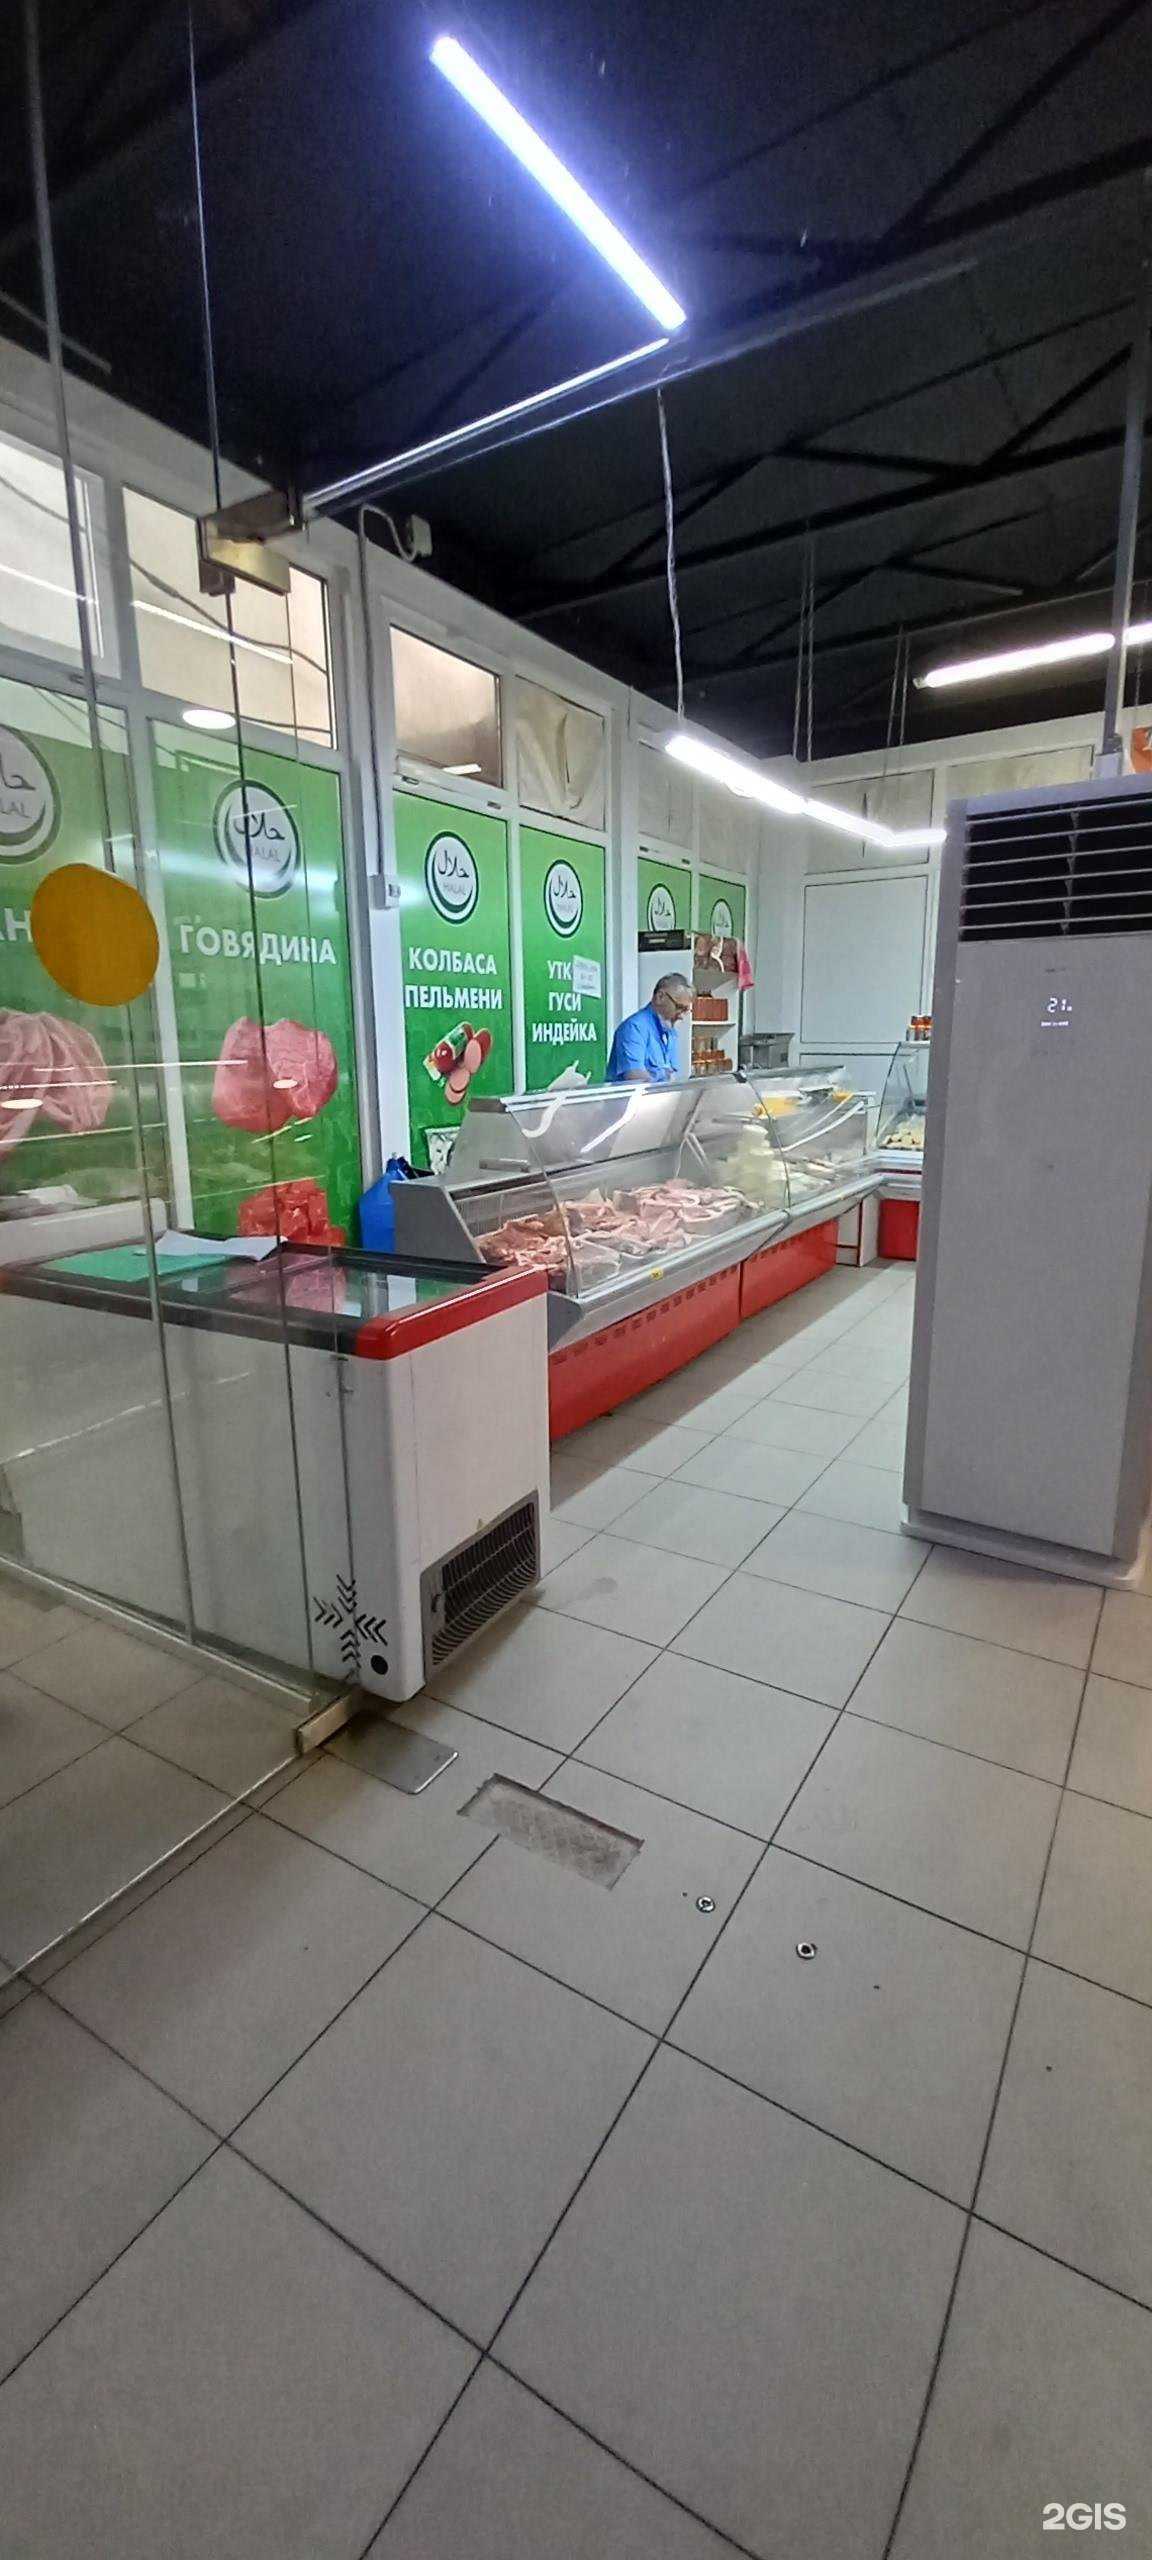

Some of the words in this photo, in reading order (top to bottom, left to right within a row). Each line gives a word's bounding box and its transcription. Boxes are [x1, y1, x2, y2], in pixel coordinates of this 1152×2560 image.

[180, 924, 336, 966] ГОВЯДИНА
[409, 947, 497, 975] КОЛБАСА
[547, 960, 573, 980] УТК
[405, 985, 503, 1009] ПЕЛЬМЕНИ
[549, 992, 582, 1011] ГУСИ
[532, 1018, 597, 1046] ИНДЕЙКА
